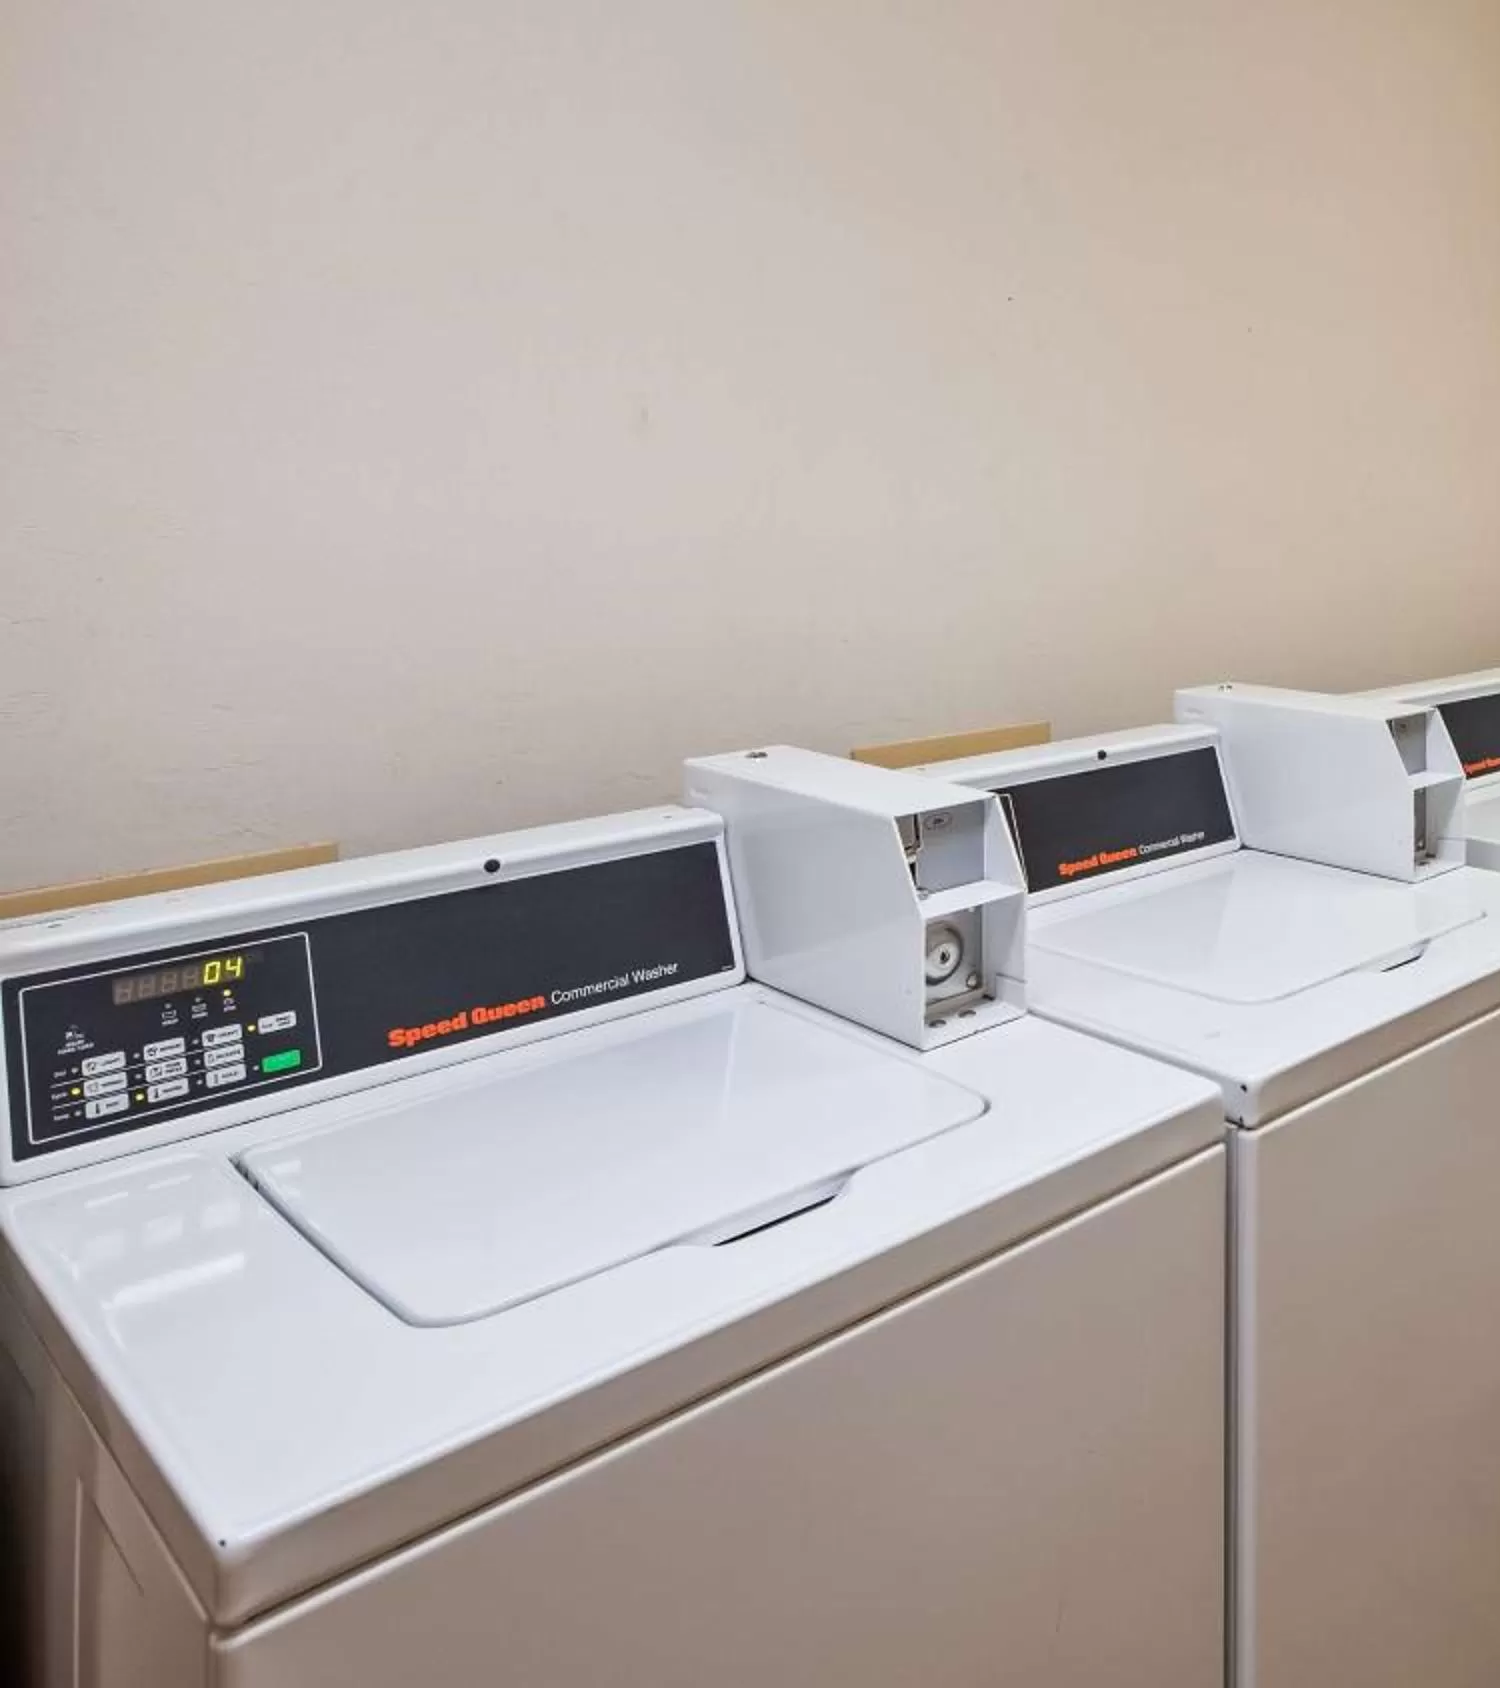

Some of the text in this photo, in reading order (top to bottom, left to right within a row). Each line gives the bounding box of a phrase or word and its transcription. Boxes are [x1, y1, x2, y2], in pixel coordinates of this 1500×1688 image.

[203, 956, 243, 985] 04
[387, 961, 680, 1048] Speed Queen Commercial Washer
